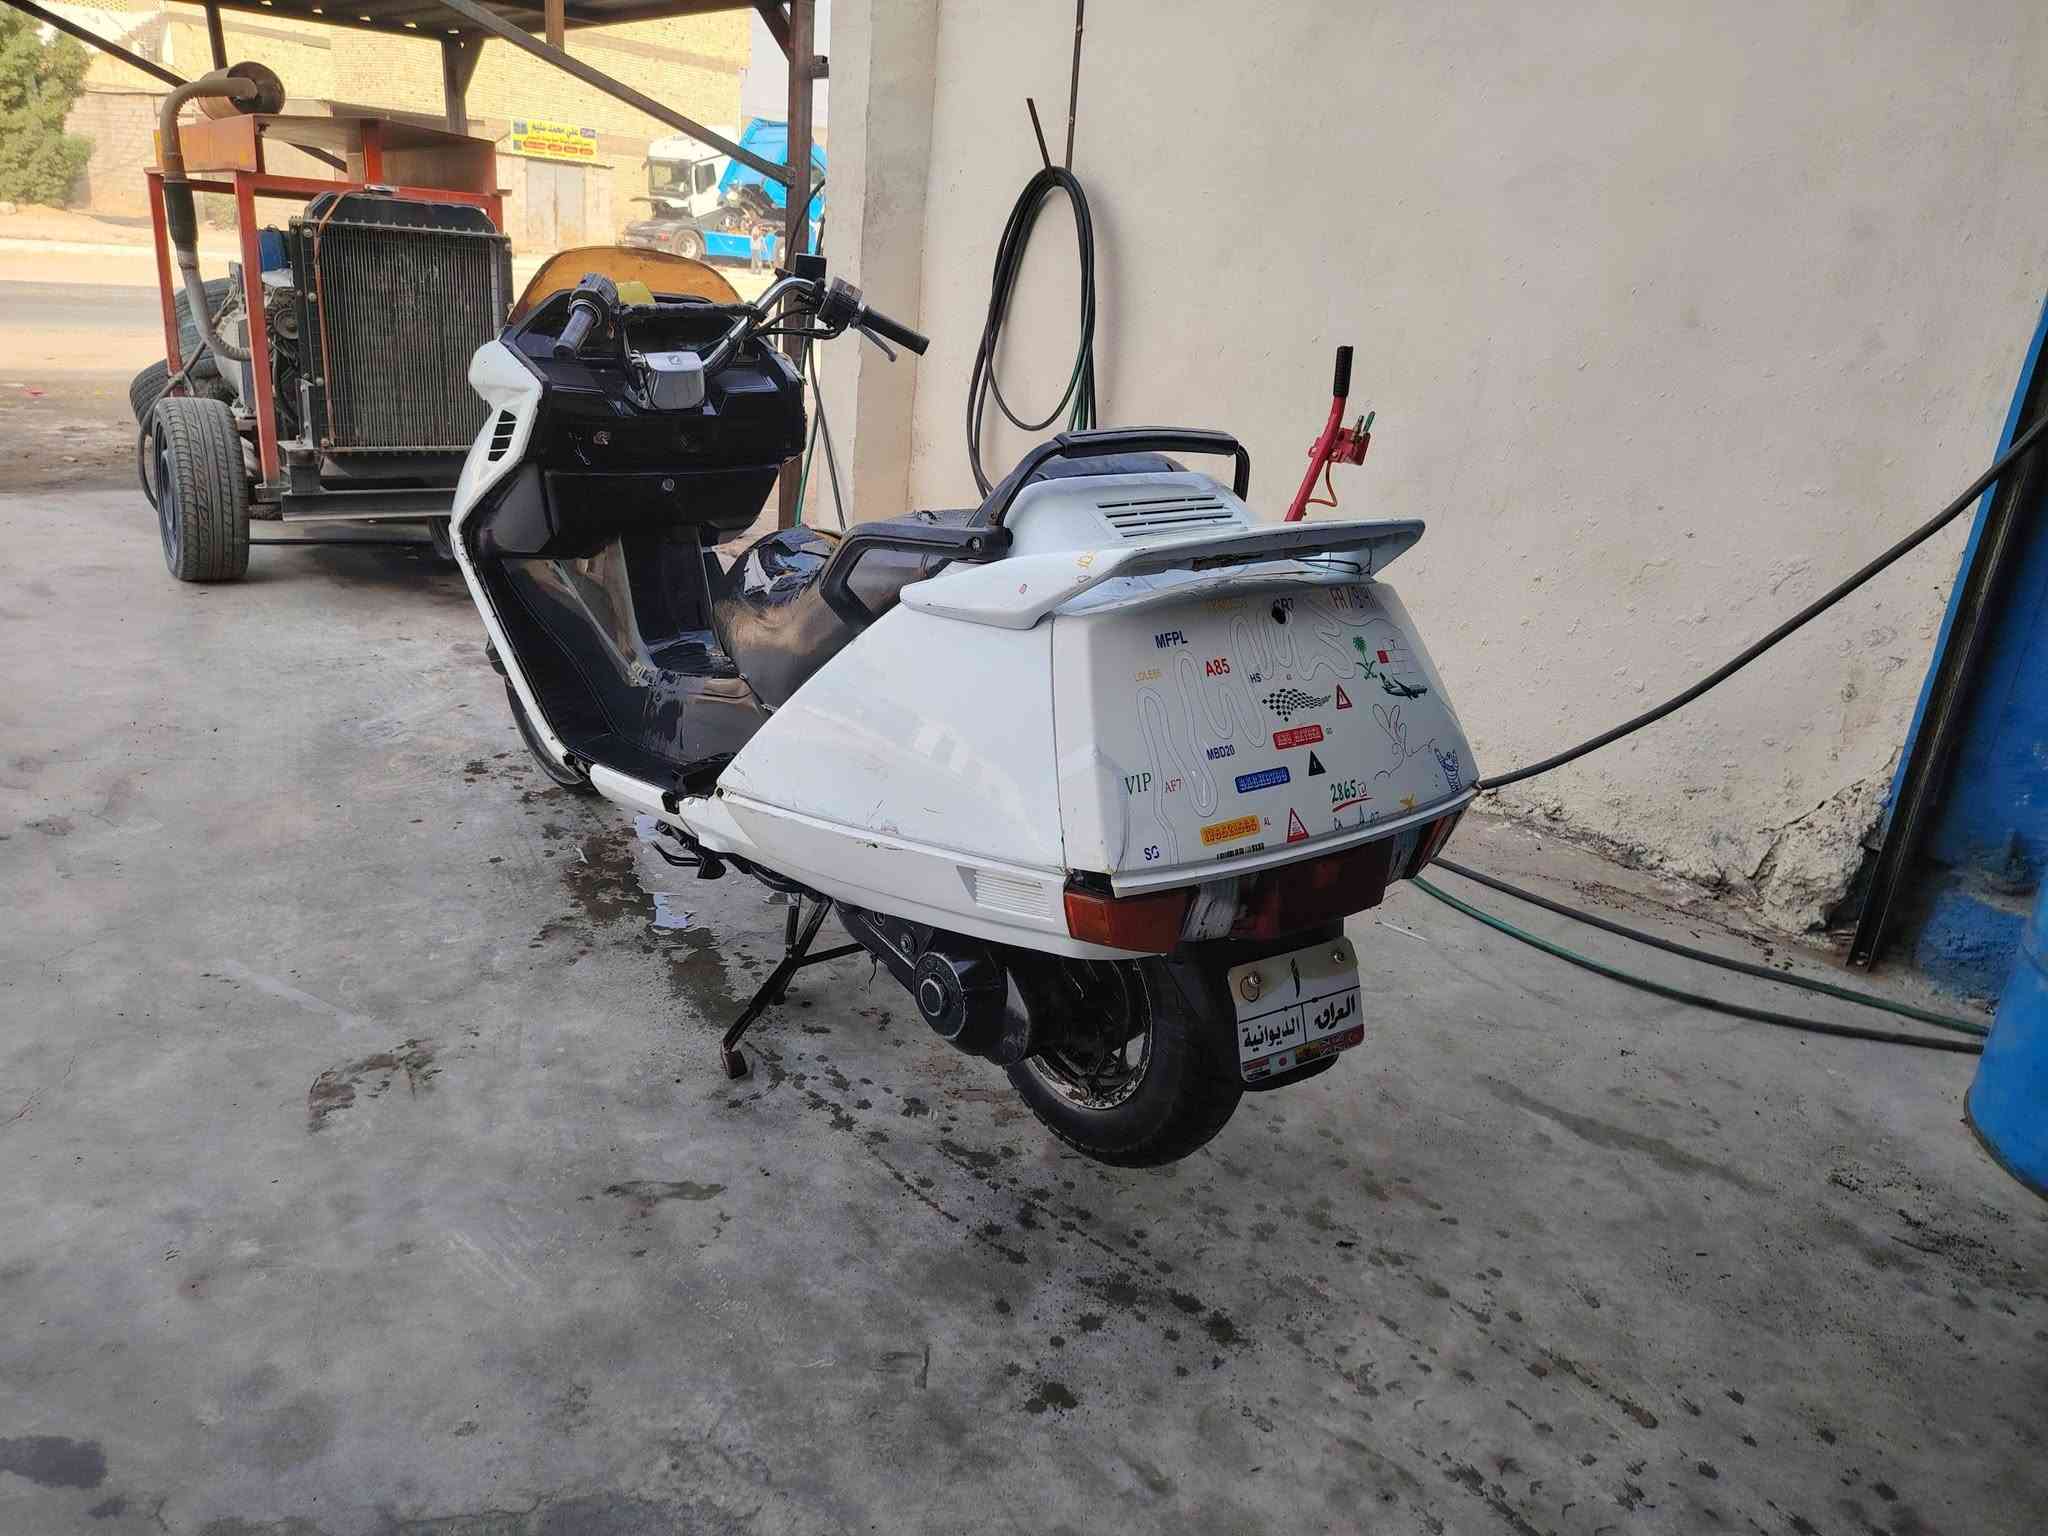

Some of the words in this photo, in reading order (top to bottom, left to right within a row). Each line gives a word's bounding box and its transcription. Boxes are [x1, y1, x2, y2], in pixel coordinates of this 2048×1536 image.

[1155, 630, 1188, 648] MFPL
[1205, 658, 1231, 677] A85
[1249, 672, 1262, 683] HS
[1206, 744, 1235, 760] MBD20
[1124, 772, 1152, 795] VIP
[1330, 779, 1357, 803] 2865
[1144, 845, 1160, 860] SG
[1314, 994, 1356, 1030] العراق
[1242, 1016, 1300, 1052] الديوانية
